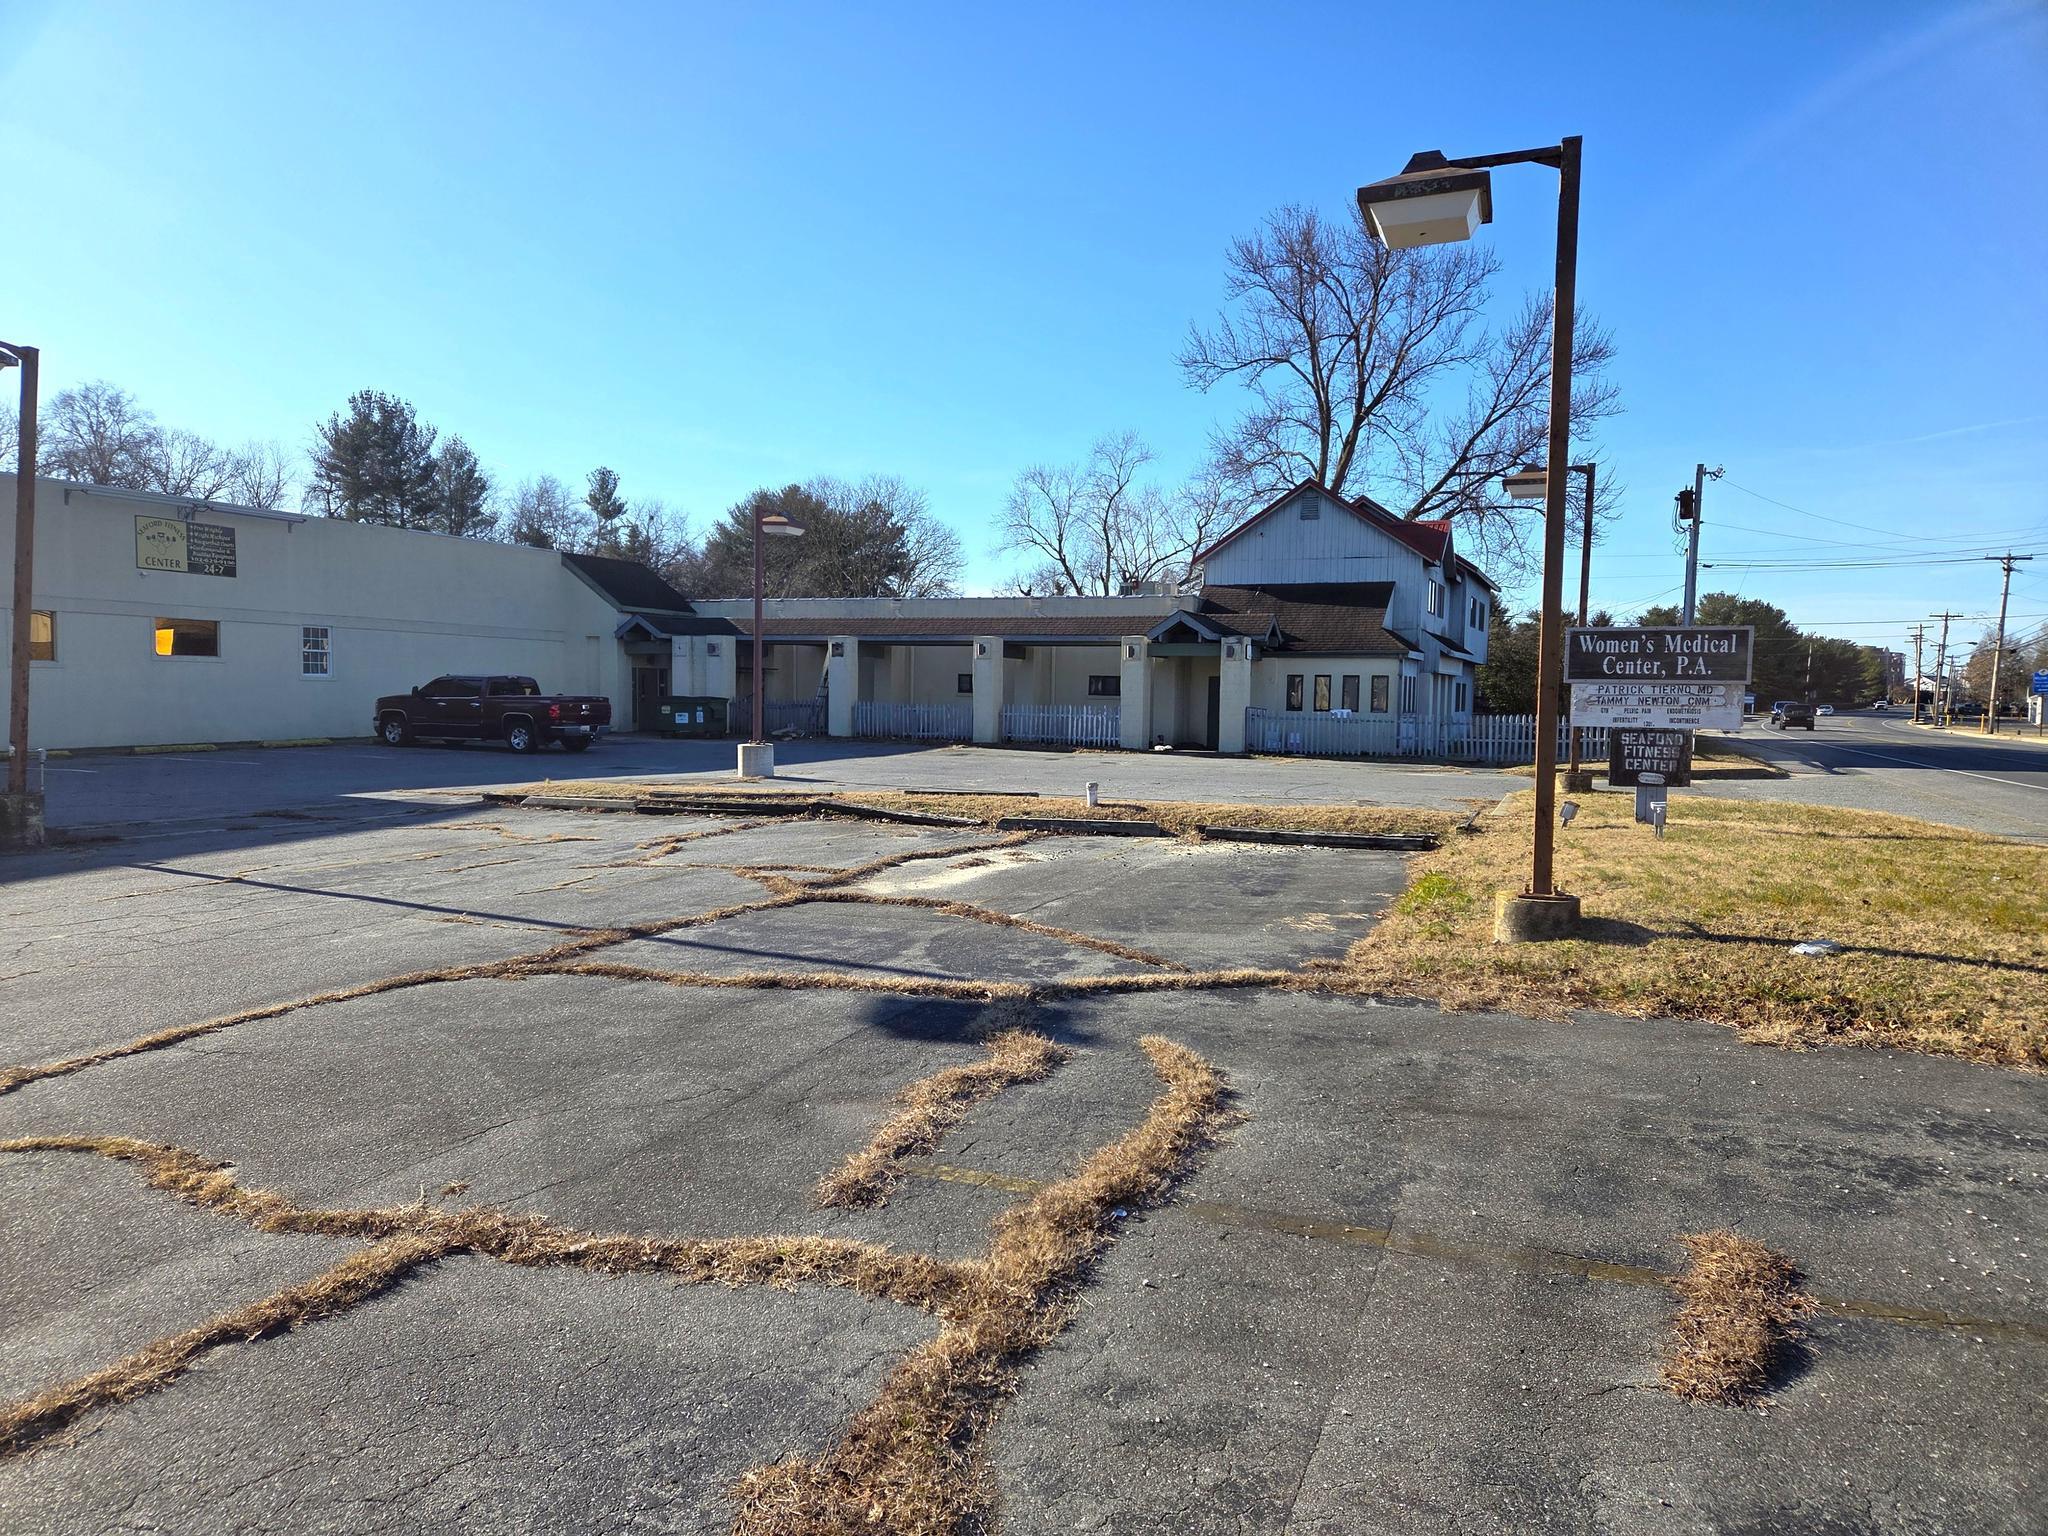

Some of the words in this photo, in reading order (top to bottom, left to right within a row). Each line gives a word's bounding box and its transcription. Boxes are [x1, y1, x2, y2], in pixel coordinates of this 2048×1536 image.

[145, 556, 181, 569] CENTER
[204, 564, 224, 574] 24-7
[1579, 634, 1654, 653] Women's
[1665, 633, 1737, 653] Medical
[1602, 656, 1666, 678] Center,
[1676, 656, 1712, 675] P.A.
[1598, 685, 1644, 695] PATRICK
[1698, 685, 1713, 695] MD
[1596, 696, 1630, 705] TAMMY
[1638, 696, 1680, 706] NEWTON
[1621, 732, 1684, 746] SEAFORD
[1624, 745, 1680, 758] FITNESS
[1625, 758, 1678, 772] CENTER
